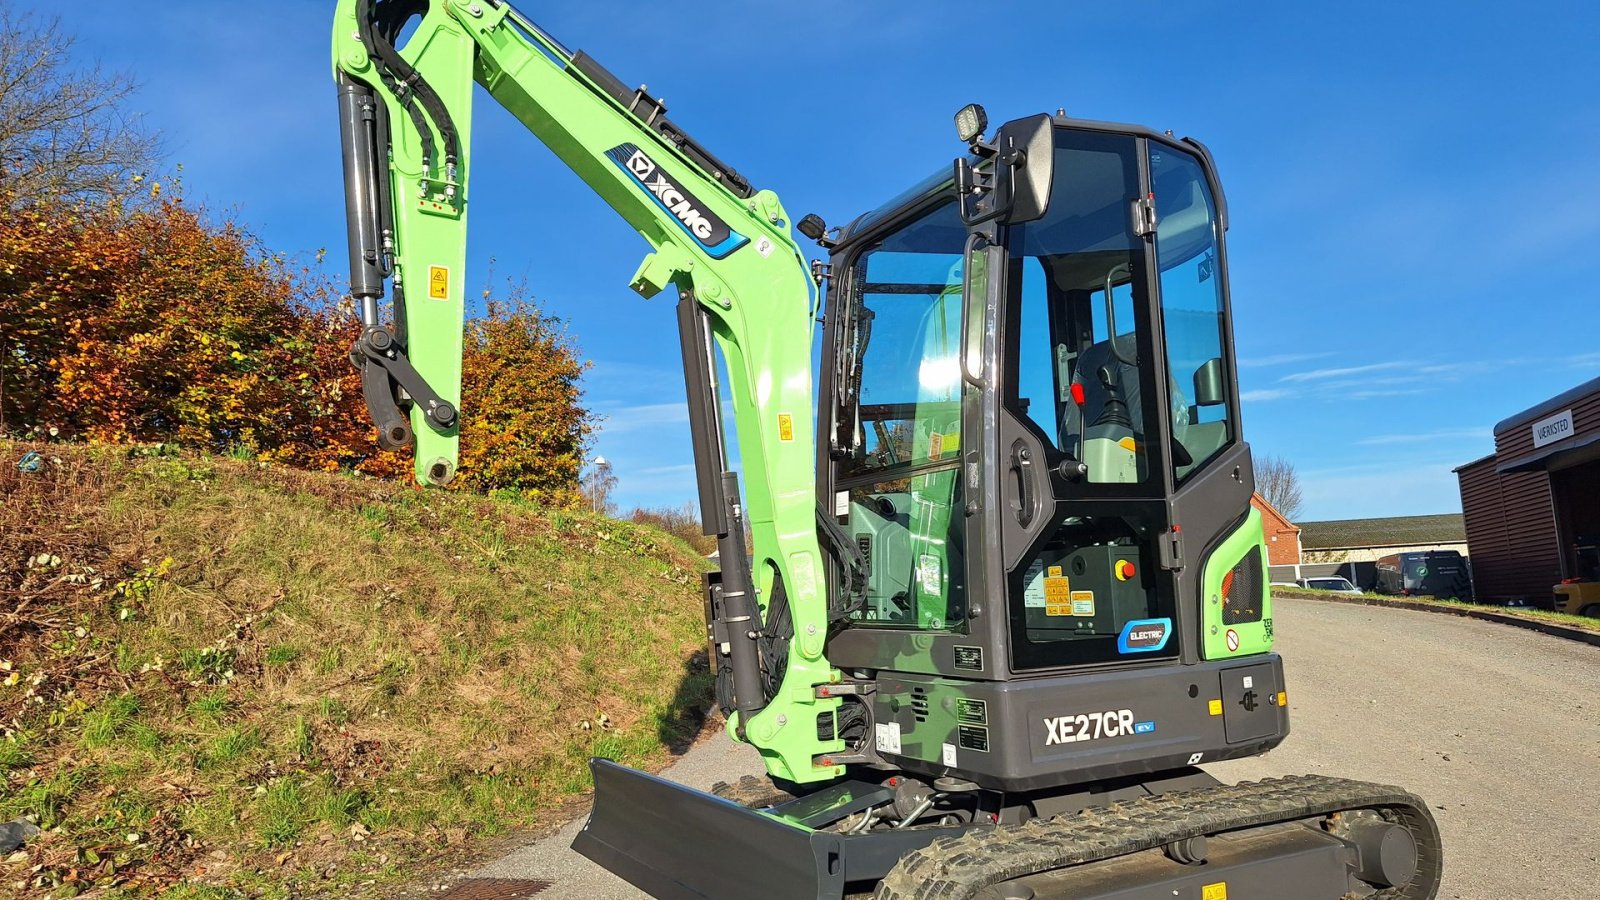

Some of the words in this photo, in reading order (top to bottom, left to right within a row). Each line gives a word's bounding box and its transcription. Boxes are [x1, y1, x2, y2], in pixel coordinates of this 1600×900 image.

[644, 172, 712, 239] XCMG
[1537, 418, 1569, 440] VÆRKSTED
[1130, 630, 1162, 641] ELECTRIC
[1043, 709, 1135, 746] XE27CR
